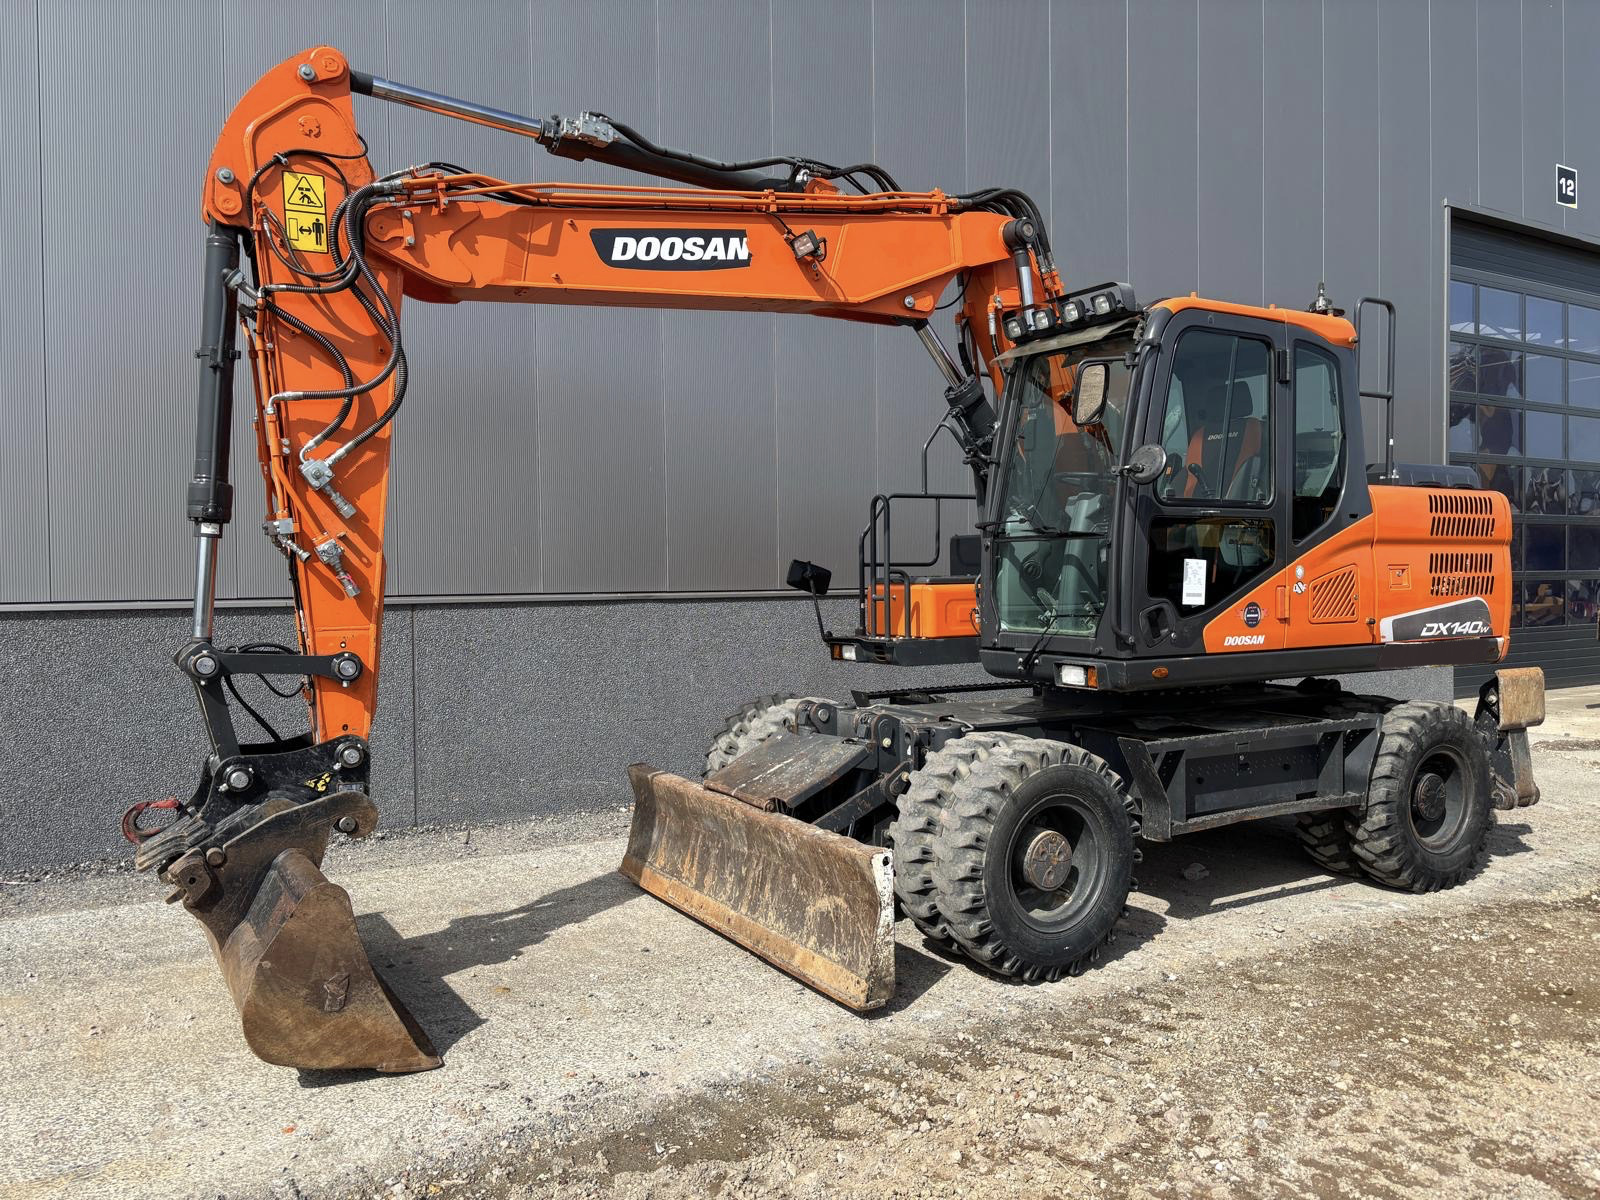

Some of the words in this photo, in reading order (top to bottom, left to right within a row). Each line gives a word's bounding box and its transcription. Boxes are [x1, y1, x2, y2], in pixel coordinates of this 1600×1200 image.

[1559, 177, 1574, 196] 12
[611, 236, 749, 261] DOOSAN
[1224, 634, 1265, 646] DOOSAN
